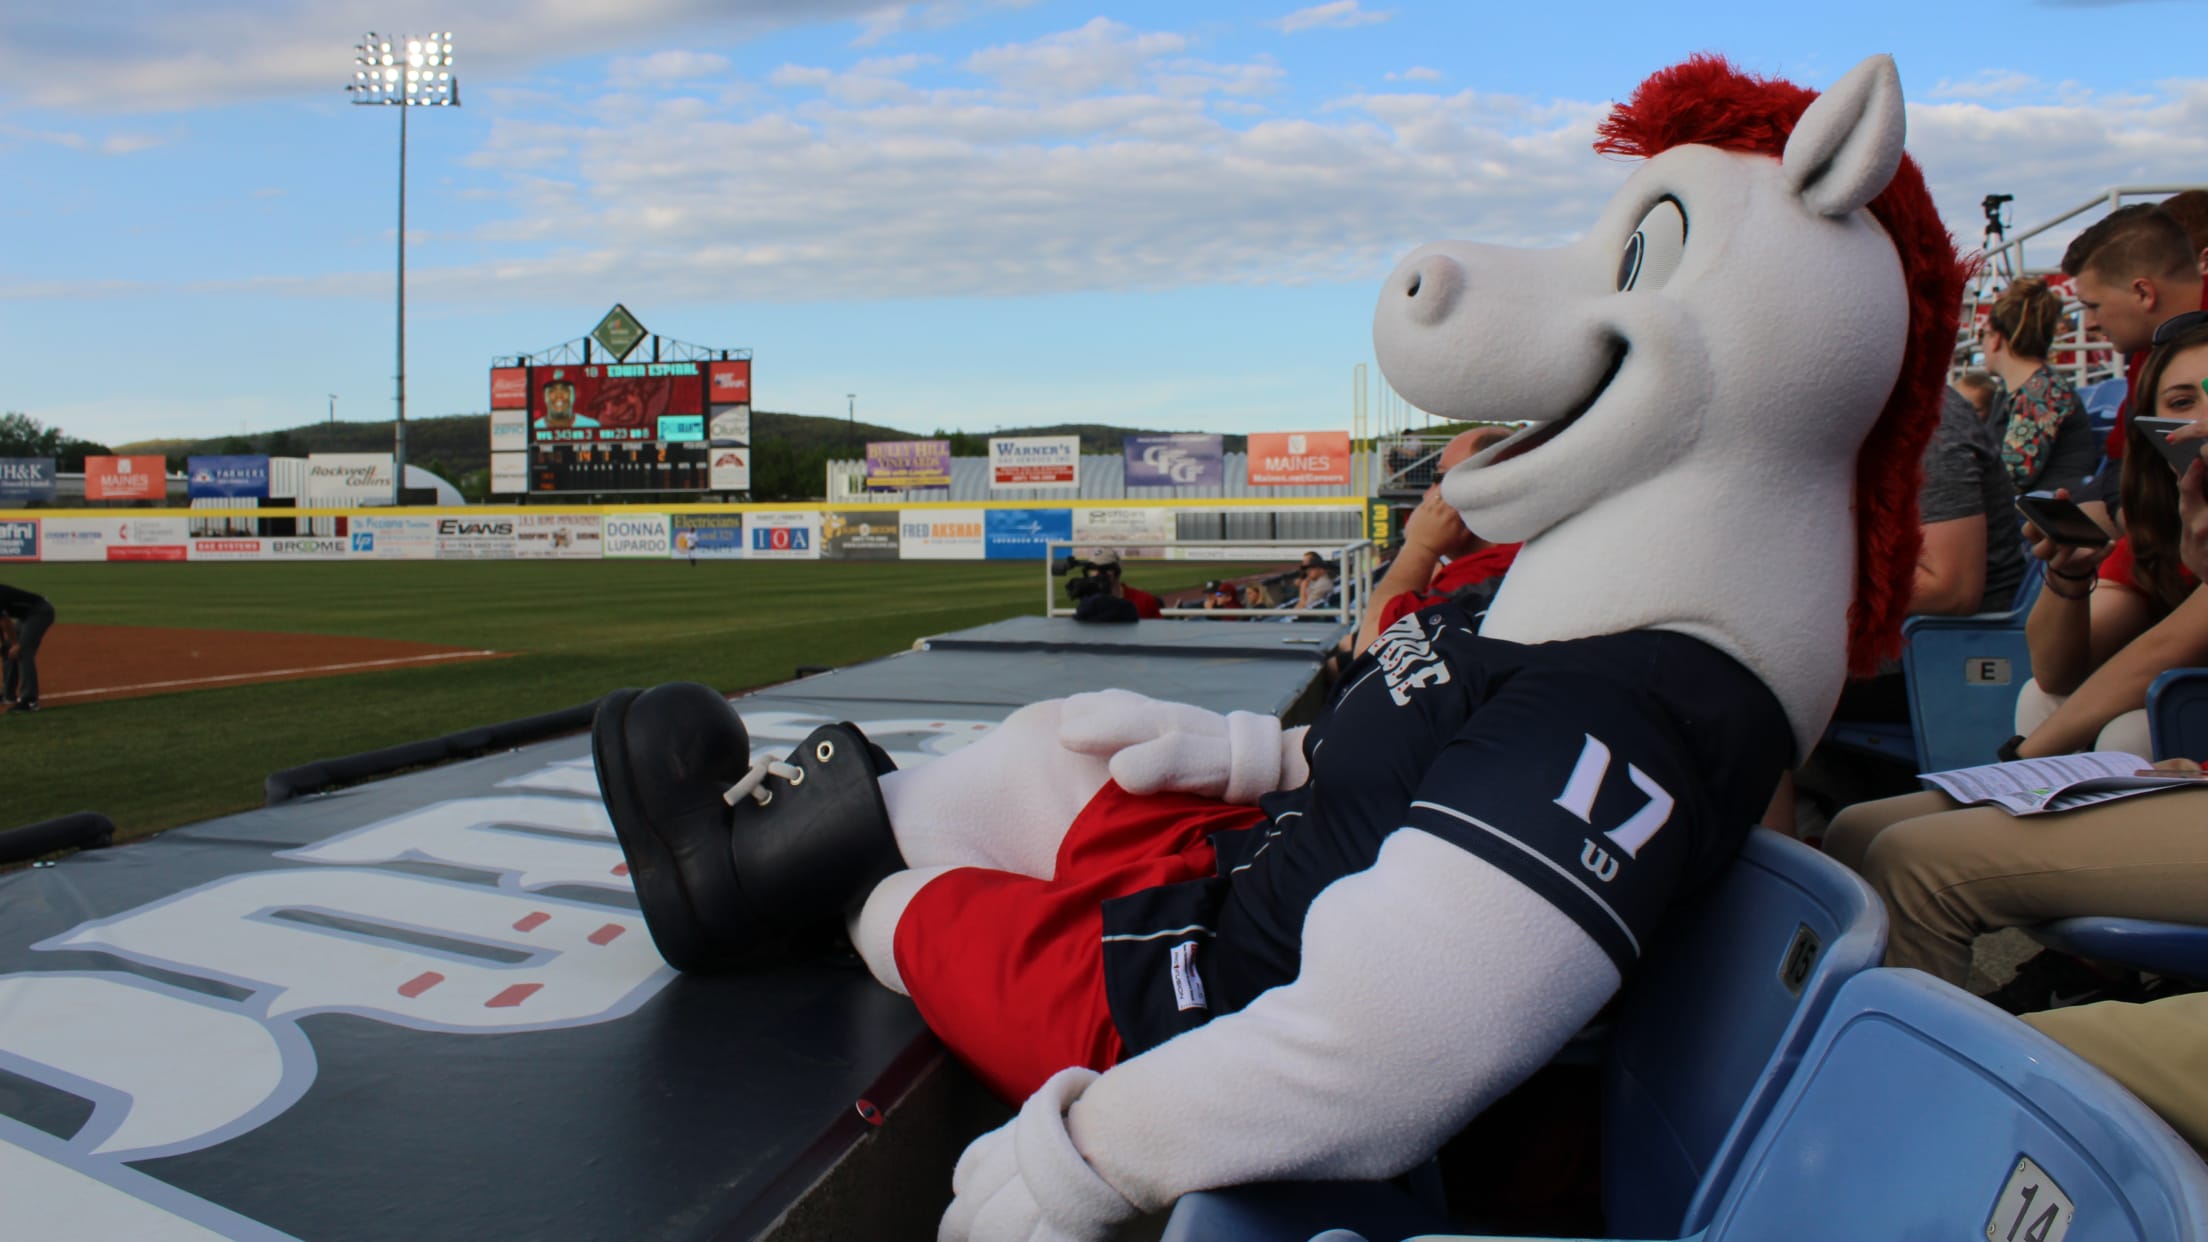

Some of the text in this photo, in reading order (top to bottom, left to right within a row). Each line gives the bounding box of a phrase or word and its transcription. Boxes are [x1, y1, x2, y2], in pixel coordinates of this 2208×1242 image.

[648, 363, 699, 377] ESPINAL
[1265, 457, 1331, 472] MAINES
[101, 474, 149, 487] MAINES
[216, 469, 265, 480] FARMERS
[310, 465, 378, 482] Rockwell
[345, 475, 392, 489] Collins
[439, 519, 513, 535] EVANS
[607, 522, 666, 537] DONNA
[903, 523, 929, 539] FRED
[932, 523, 983, 538] AKSHAR
[273, 541, 346, 553] BROOME
[607, 539, 666, 552] LUPARDO
[1980, 661, 1997, 681] E
[1552, 732, 1675, 861] 17
[2006, 1183, 2061, 1242] 14
